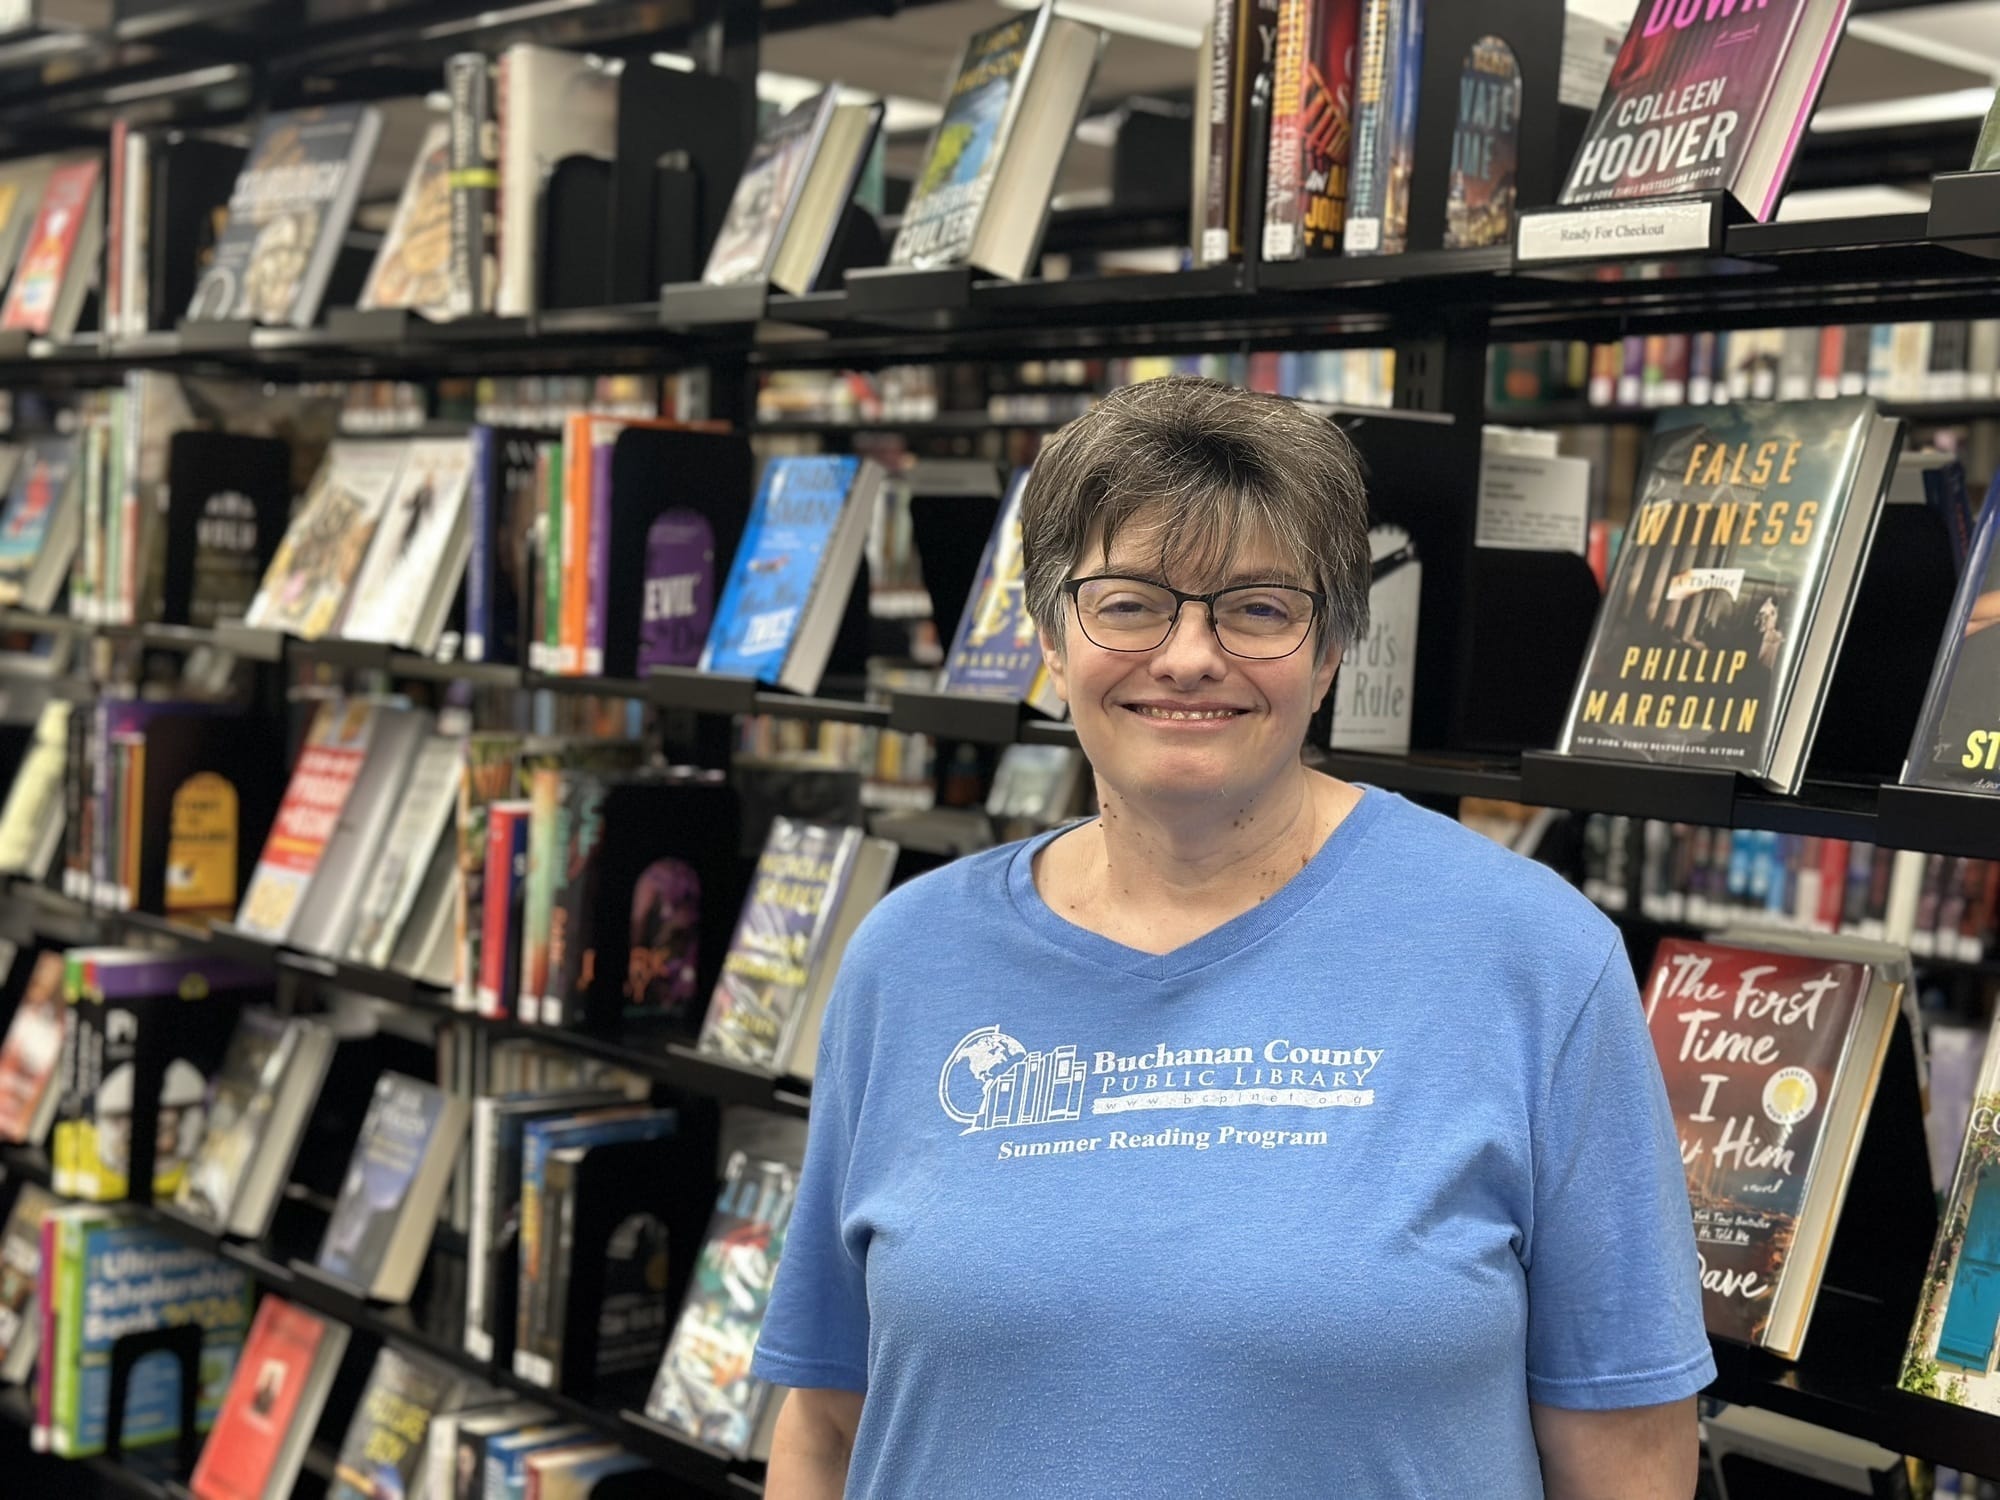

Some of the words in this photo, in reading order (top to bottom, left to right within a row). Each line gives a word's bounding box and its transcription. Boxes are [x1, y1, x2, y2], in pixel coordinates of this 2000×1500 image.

[1642, 0, 1770, 38] DOW
[1617, 77, 1728, 128] COLLEEN
[1573, 110, 1738, 188] HOOVER
[1560, 225, 1592, 244] Ready
[1594, 226, 1613, 240] For
[1615, 223, 1666, 239] Checkout
[1683, 440, 1803, 486] FALSE
[1636, 500, 1819, 546] WITNESS
[1688, 575, 1738, 588] Thriller
[1620, 646, 1747, 684] PHILLIP
[1352, 671, 1404, 718] Rule
[1582, 690, 1758, 733] MARGOLIN
[1577, 736, 1595, 745] NEW
[1597, 738, 1620, 748] YORK
[1622, 740, 1649, 750] TIMES
[1650, 742, 1707, 755] BESTSELLING
[1709, 746, 1745, 757] AUTHOR
[1667, 953, 1727, 1000] The
[1733, 965, 1840, 1031] First
[1092, 1043, 1254, 1075] Buchanan
[1264, 1039, 1384, 1075] County
[1678, 1009, 1780, 1065] Time
[1102, 1070, 1216, 1093] PUBLIC
[1234, 1067, 1367, 1088] LIBRARY
[1689, 1074, 1729, 1122] I
[998, 1136, 1102, 1160] Summer
[1109, 1128, 1211, 1150] Reading
[1216, 1126, 1328, 1148] Program
[1712, 1115, 1795, 1175] Him
[1750, 1179, 1783, 1193] novel
[1699, 1224, 1711, 1239] He
[1714, 1227, 1734, 1241] Told
[1735, 1229, 1750, 1243] Me
